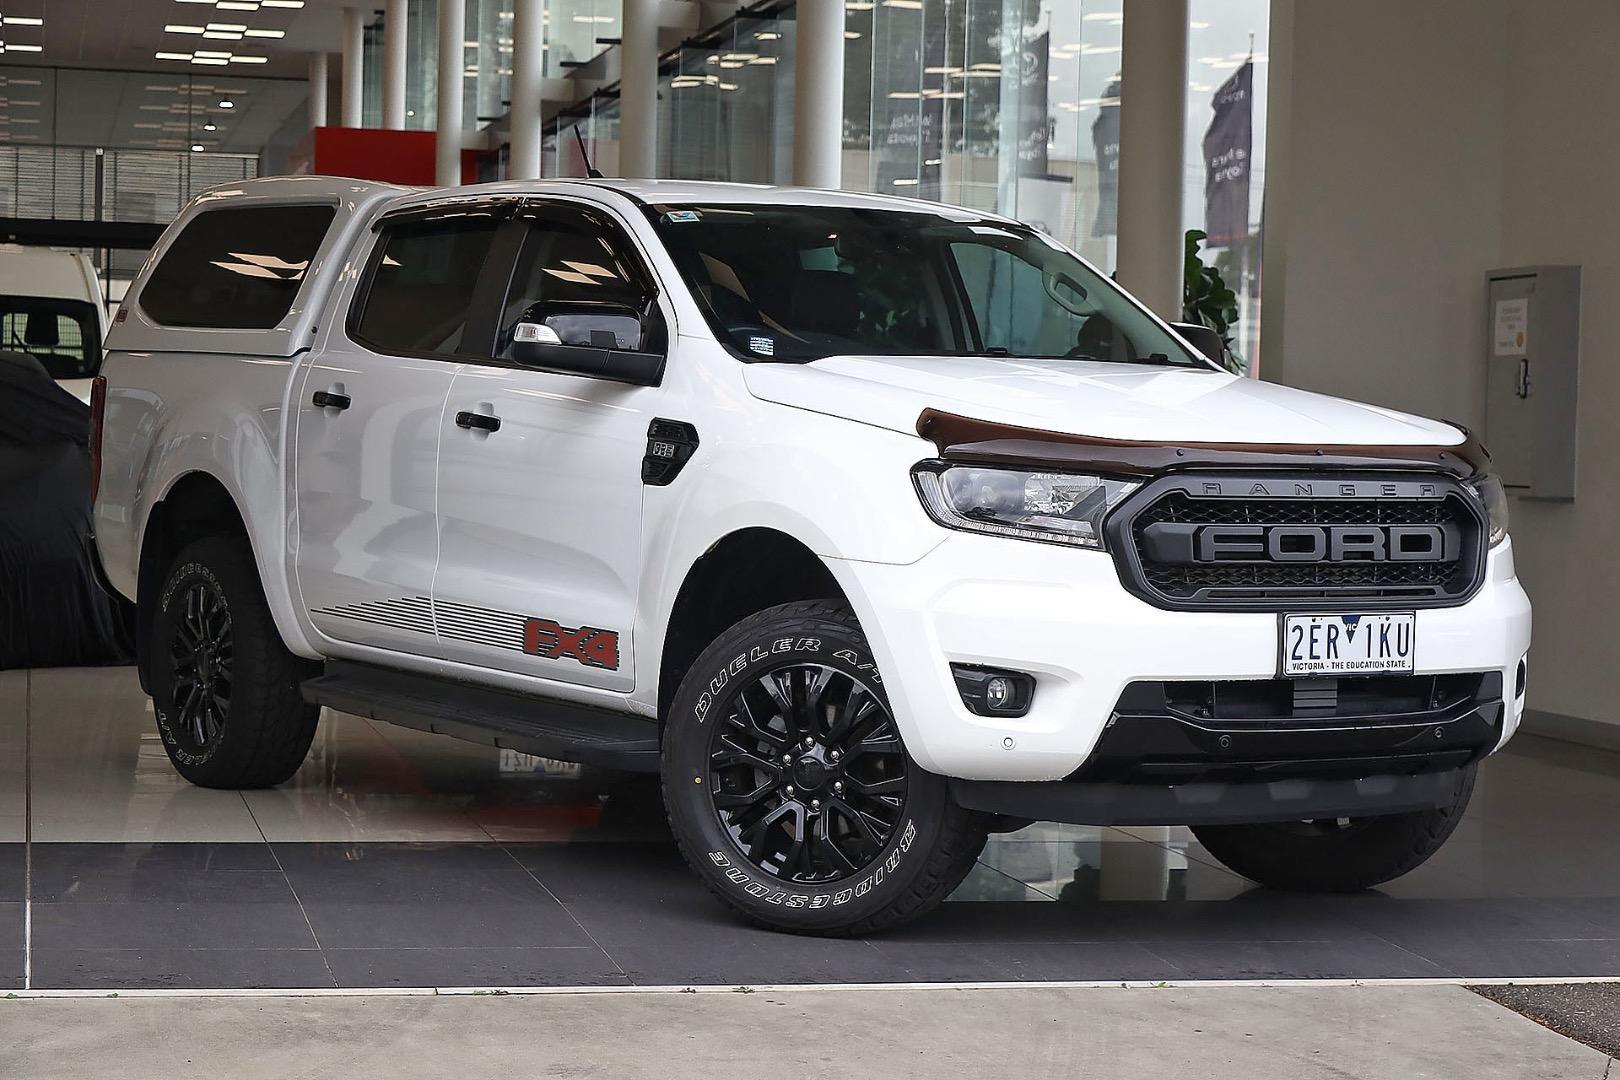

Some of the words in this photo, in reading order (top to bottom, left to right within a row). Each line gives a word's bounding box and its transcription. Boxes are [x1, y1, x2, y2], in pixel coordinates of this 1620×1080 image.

[1203, 483, 1436, 496] RANGER
[1199, 524, 1443, 562] FORD
[522, 616, 620, 671] FX4
[1291, 624, 1339, 660] 2ER
[1365, 623, 1410, 658] 1KU
[694, 637, 821, 723] DUELER
[1292, 661, 1325, 671] VICTORIA
[1331, 661, 1345, 670] THE
[1346, 660, 1385, 669] EDUCATION
[1386, 660, 1406, 668] STATE
[708, 819, 916, 910] BRIDGESTONE
